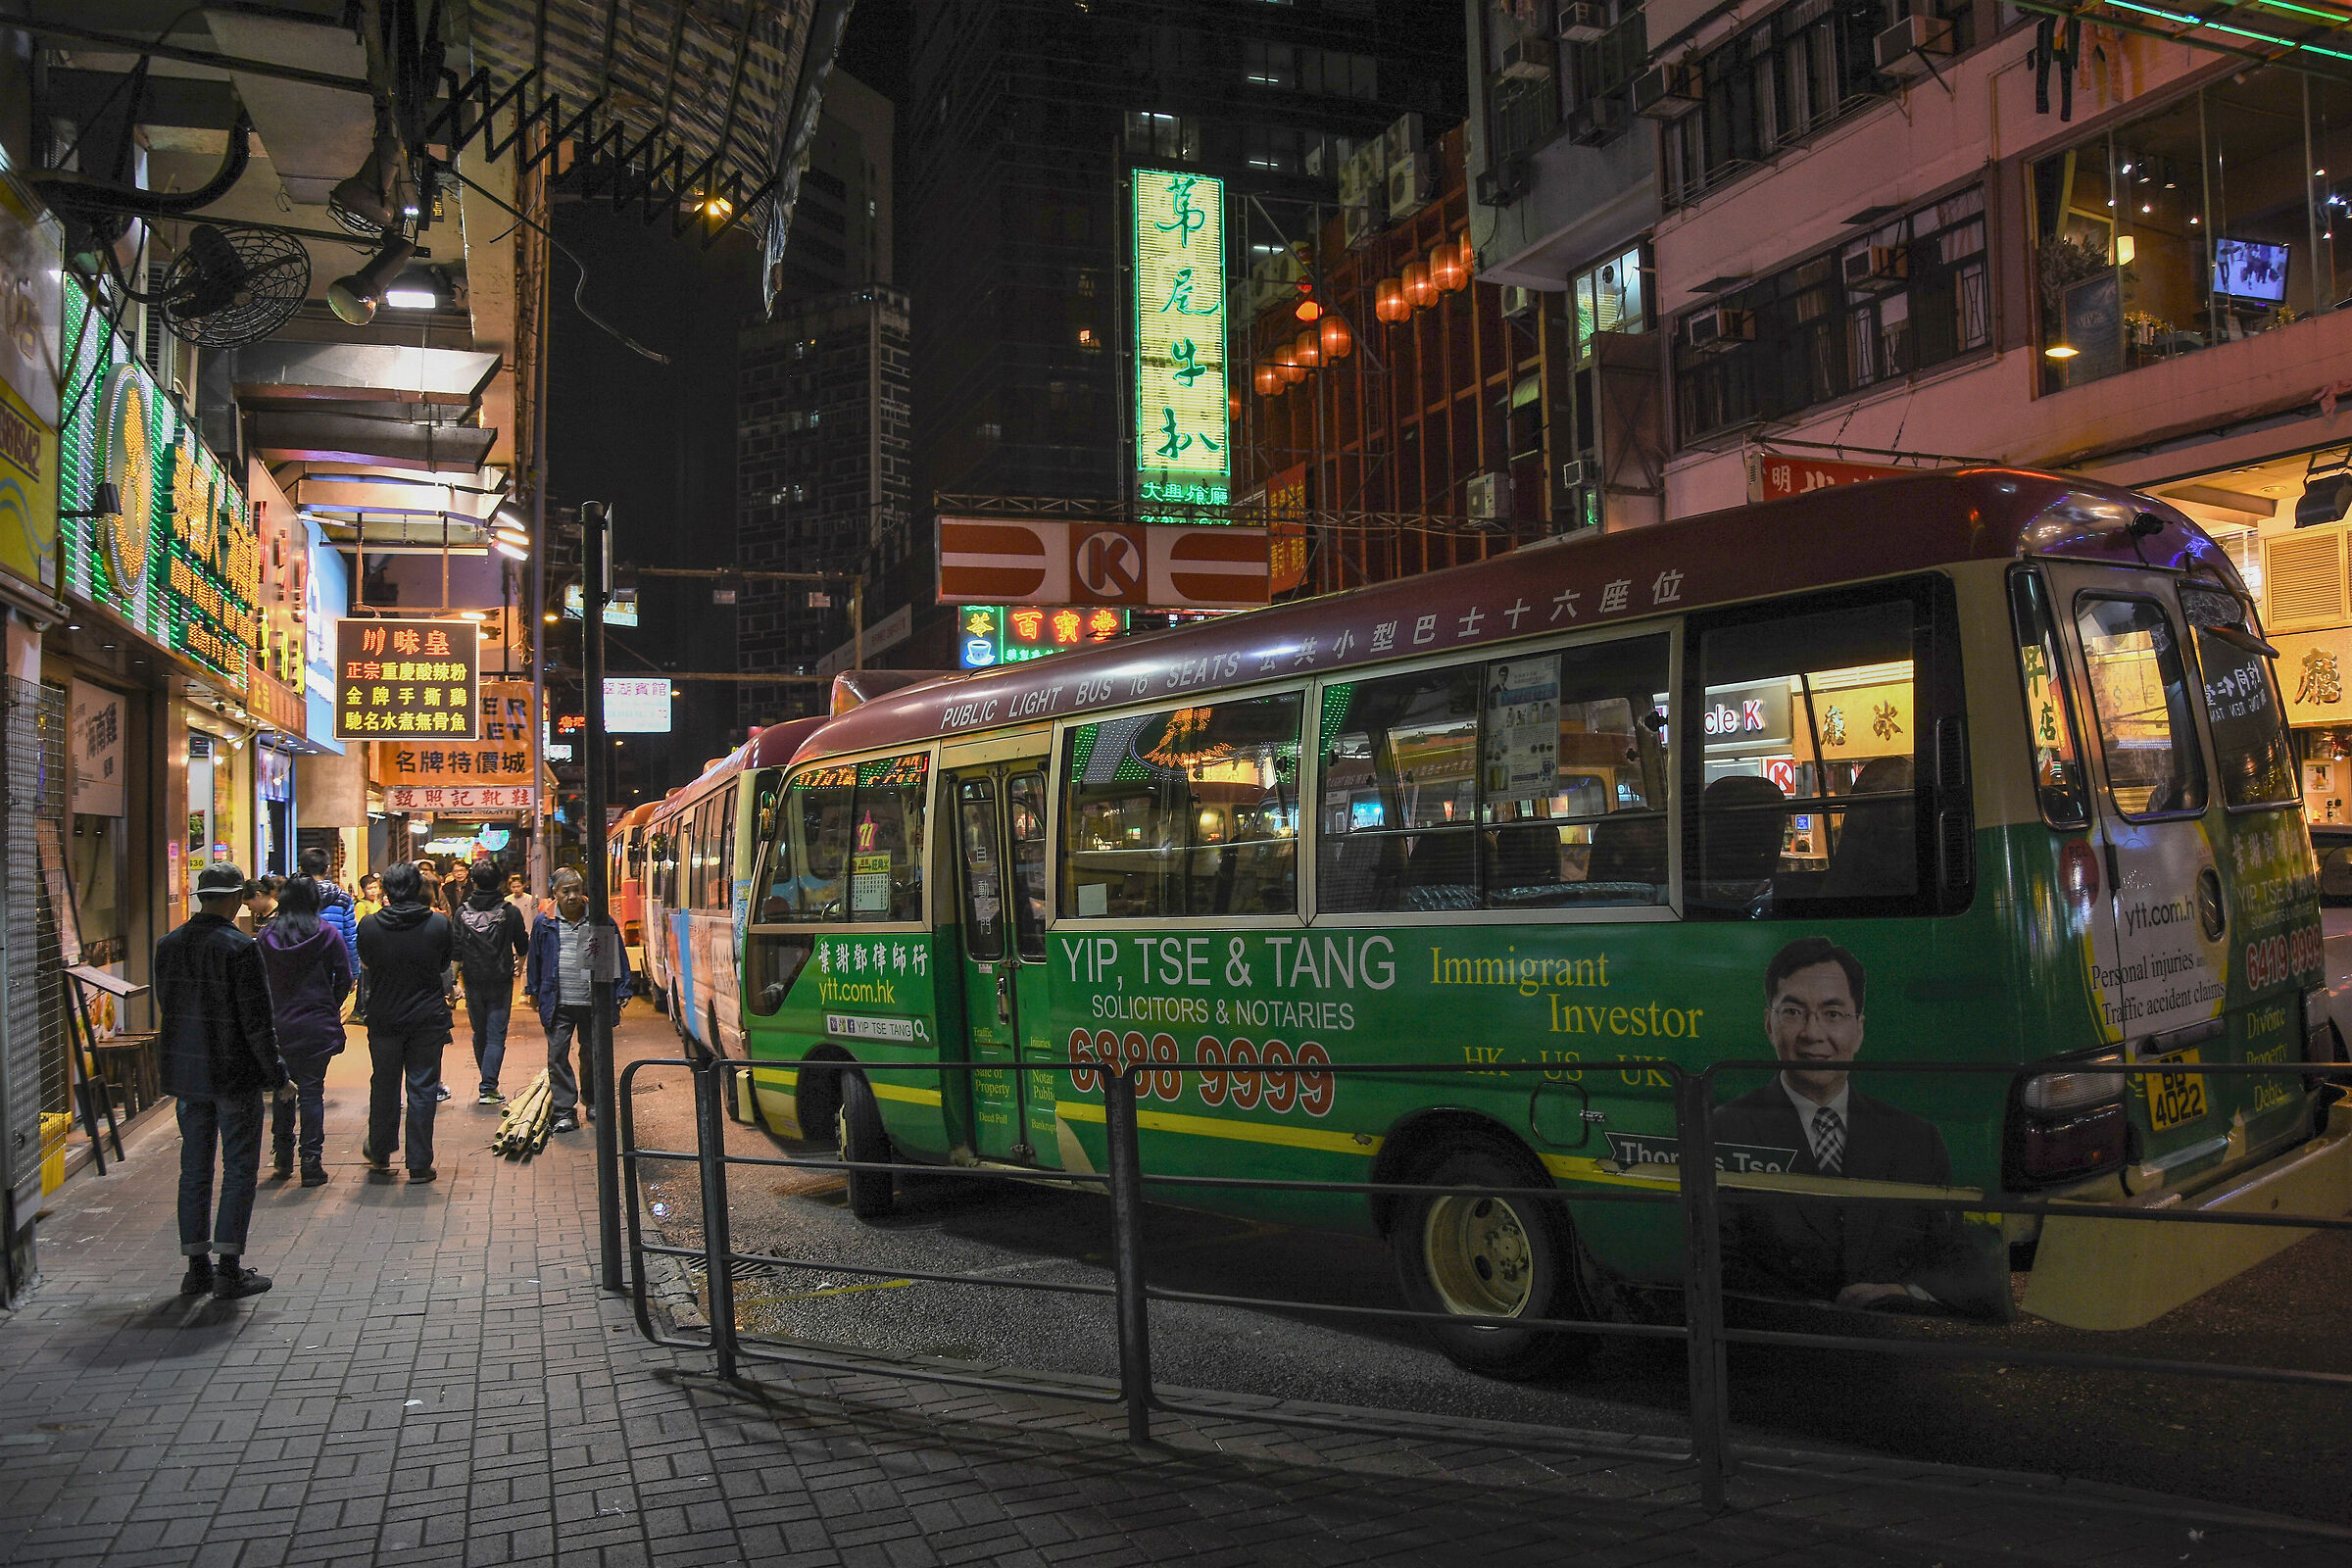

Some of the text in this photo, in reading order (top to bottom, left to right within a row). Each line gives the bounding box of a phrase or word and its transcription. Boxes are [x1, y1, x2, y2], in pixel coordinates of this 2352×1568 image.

[363, 627, 451, 656] 川味皇
[346, 662, 467, 681] 正宗重慶酸辣粉
[941, 699, 998, 730] PUBLIC
[1008, 685, 1063, 718] LIGHT
[1075, 676, 1114, 706] BUS
[1129, 673, 1150, 696] 16
[1167, 651, 1241, 687] SEATS
[345, 711, 466, 731] 馳名水煮無骨魚
[1743, 699, 1765, 732] K
[396, 751, 525, 774] 名牌特價城
[394, 788, 531, 808] 甄照記靴鞋
[817, 941, 928, 977] 葉謝鄧律師行
[1061, 935, 1396, 992] YIP, TSE & TANG
[1429, 945, 1610, 997] Immigrant
[2091, 948, 2194, 990] Personal injuries
[2245, 934, 2289, 991] 6419
[818, 978, 896, 1005] ytt.com.hk
[2102, 980, 2226, 1026] Traffic accident claims
[857, 1021, 869, 1033] YIP
[872, 1022, 887, 1035] TSE
[890, 1023, 911, 1037] TANG
[1092, 994, 1355, 1030] SOLICITORS & NOTARIES
[1546, 993, 1703, 1039] Investor
[1068, 1027, 1336, 1117] 6888 9999
[1617, 1054, 1673, 1088] UK
[2156, 1083, 2203, 1126] 4022
